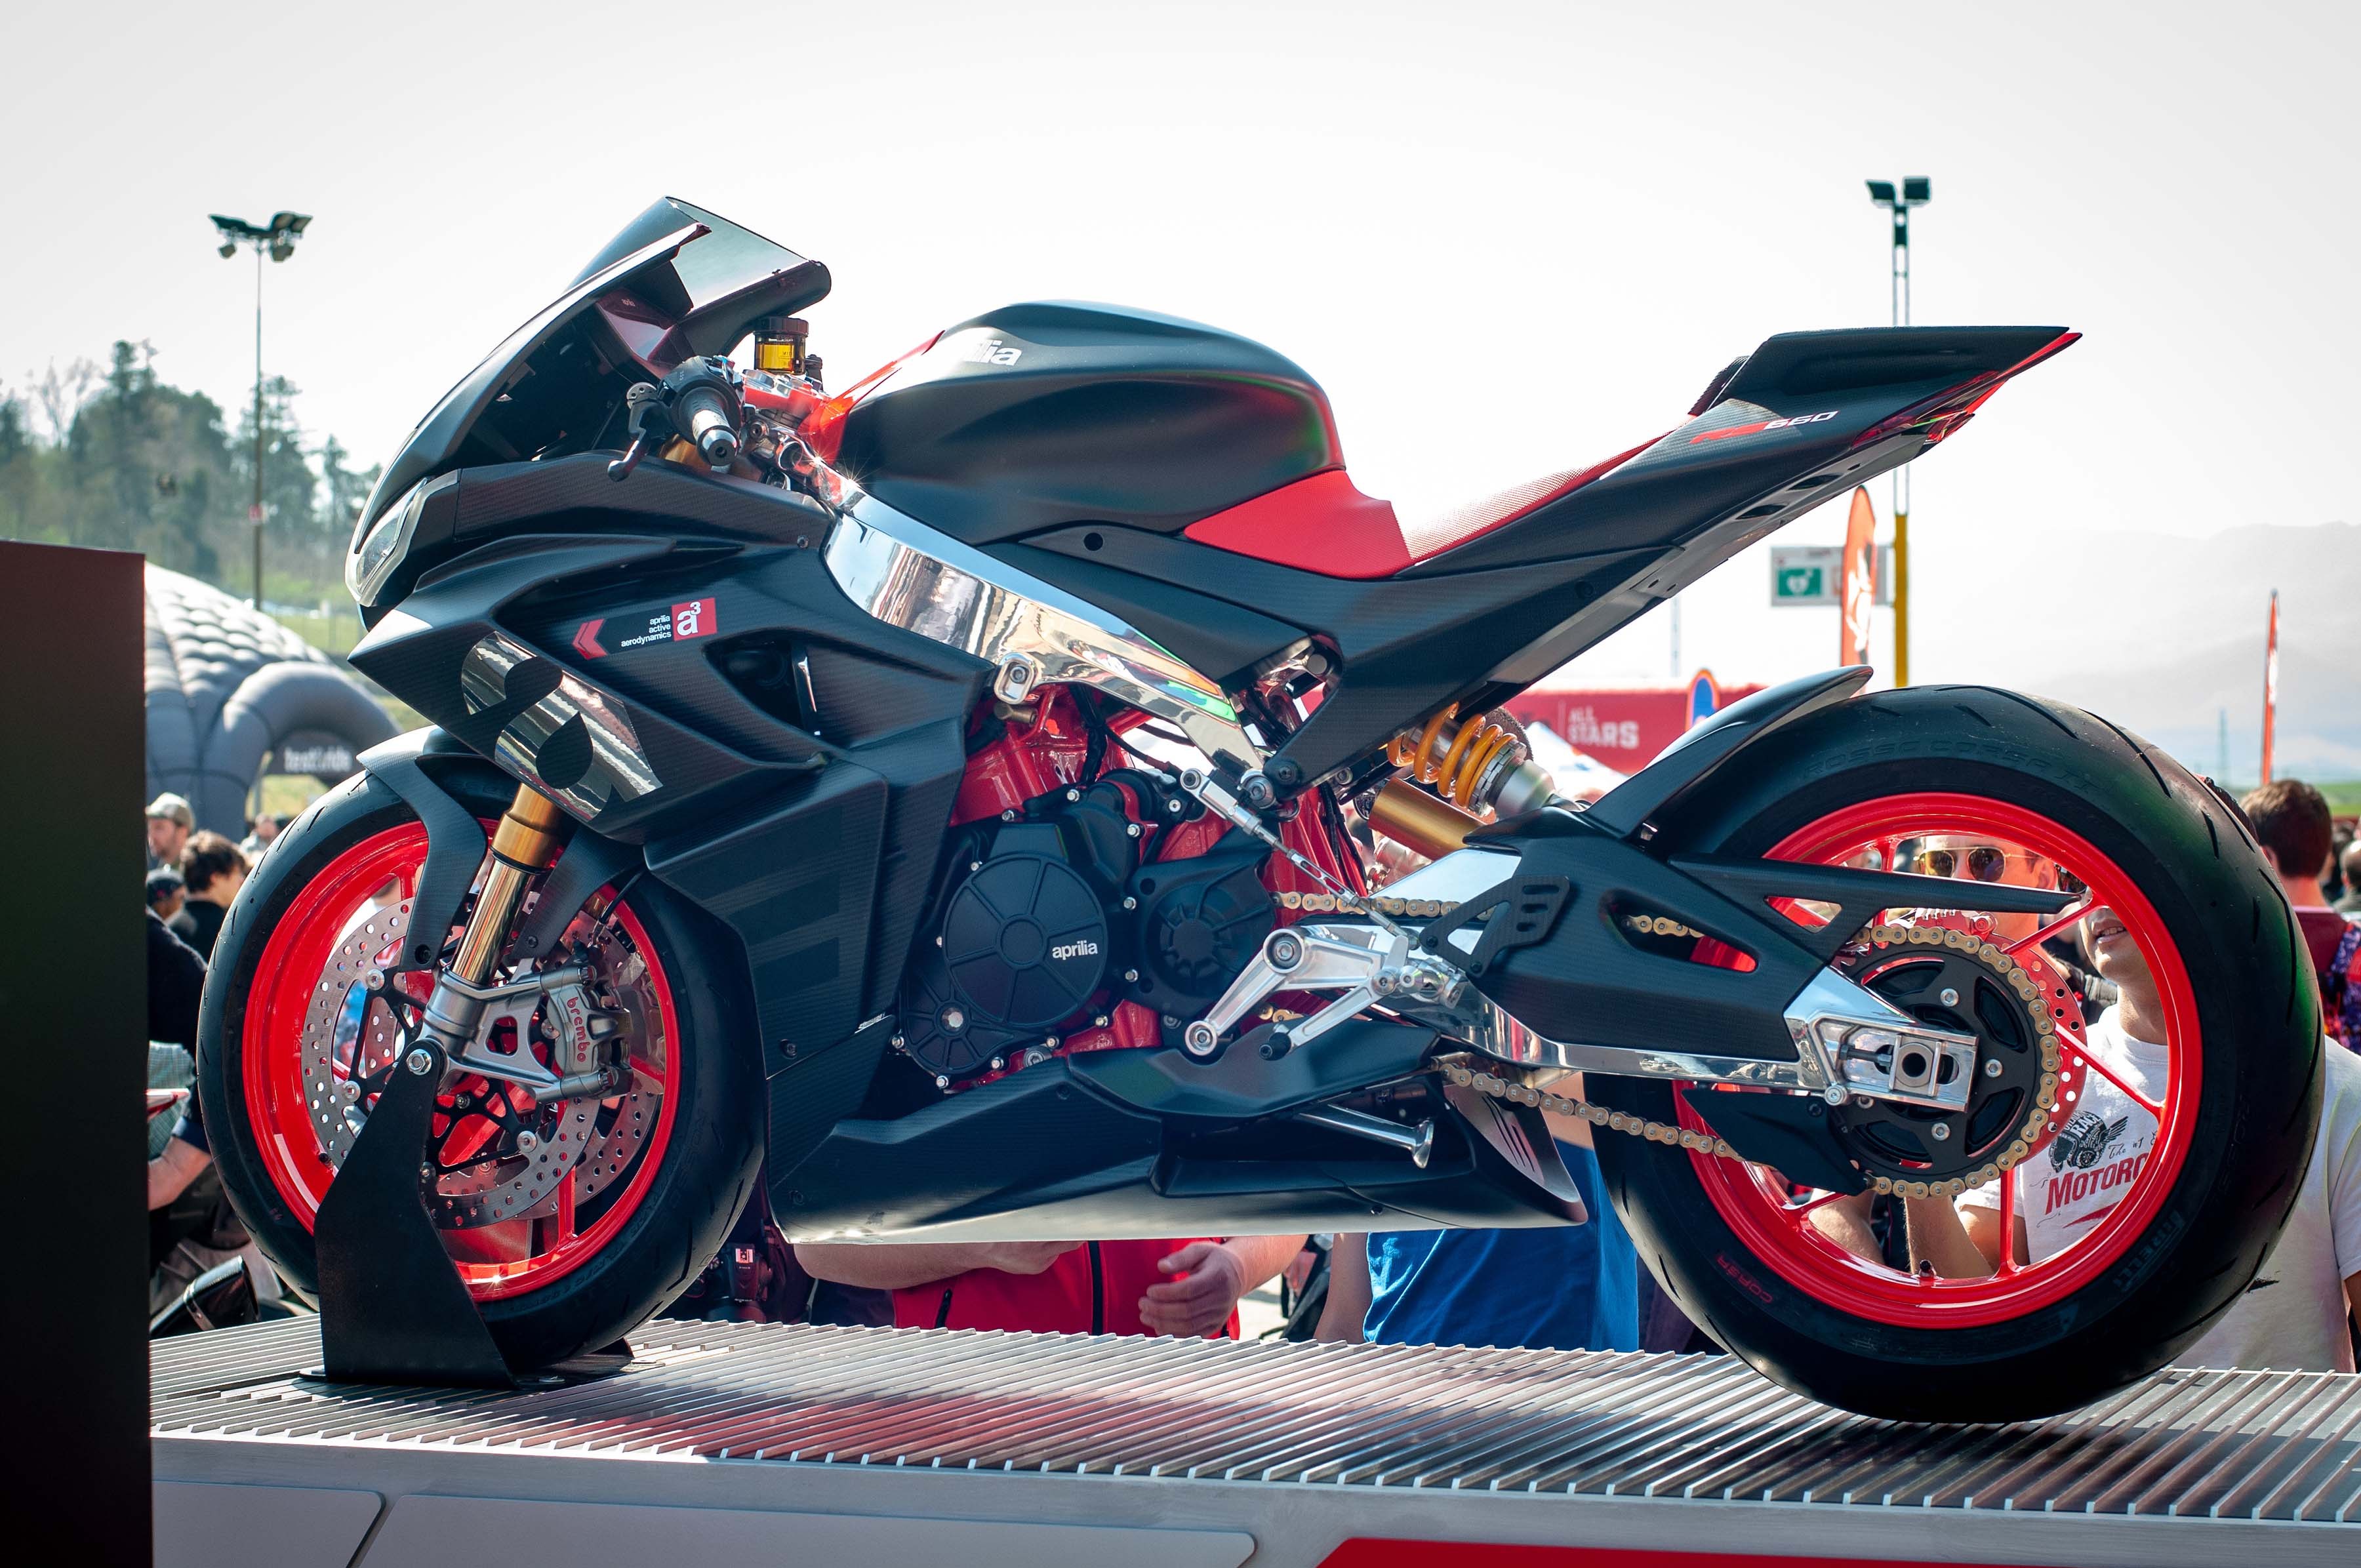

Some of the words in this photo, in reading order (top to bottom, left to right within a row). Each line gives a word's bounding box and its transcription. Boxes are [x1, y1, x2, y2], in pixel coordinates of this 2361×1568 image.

[1764, 410, 1839, 430] 660
[649, 614, 671, 626] aprilia
[649, 624, 671, 633] active
[620, 631, 672, 647] aerodynamics
[1567, 720, 1639, 750] STARS
[1052, 940, 1098, 961] aprilia
[567, 996, 591, 1062] brembo
[1716, 1254, 1773, 1304] CORSA
